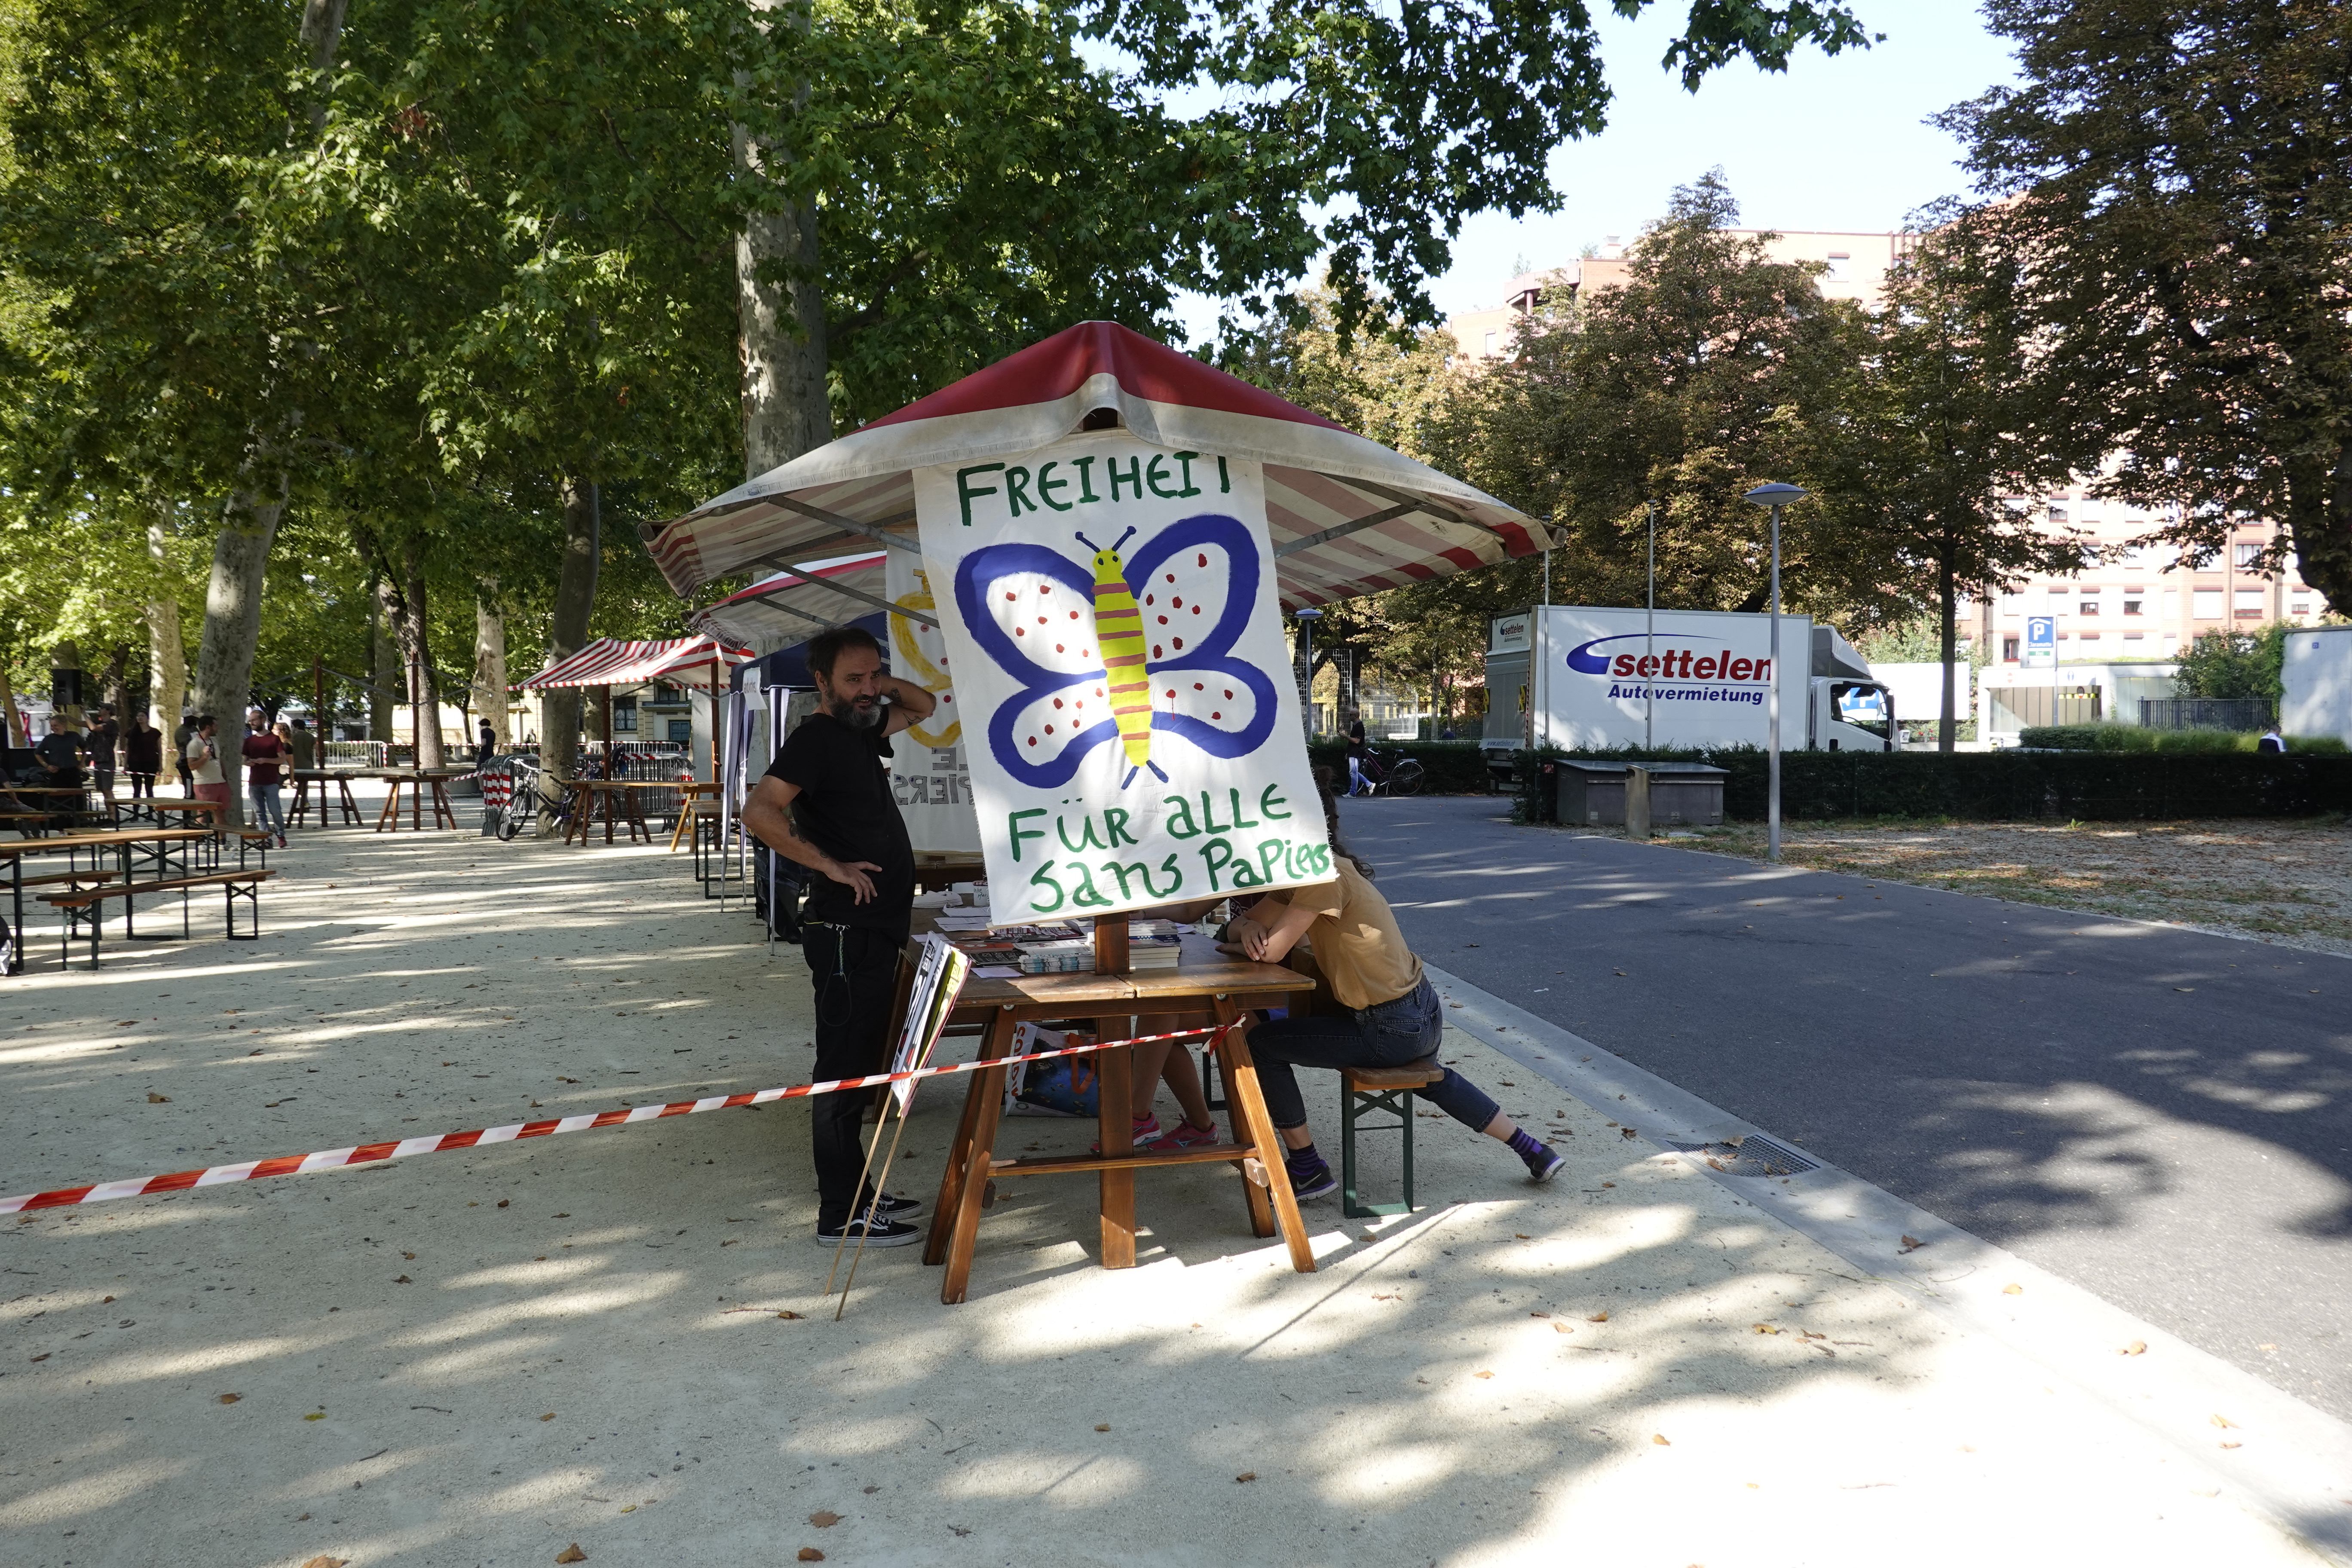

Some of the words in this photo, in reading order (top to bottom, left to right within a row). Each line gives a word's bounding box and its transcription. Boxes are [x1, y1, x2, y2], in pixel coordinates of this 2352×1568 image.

[1505, 623, 1524, 635] settelen
[2034, 623, 2045, 640] P
[1613, 649, 1771, 681] settelen
[1608, 684, 1763, 705] Autovermietung
